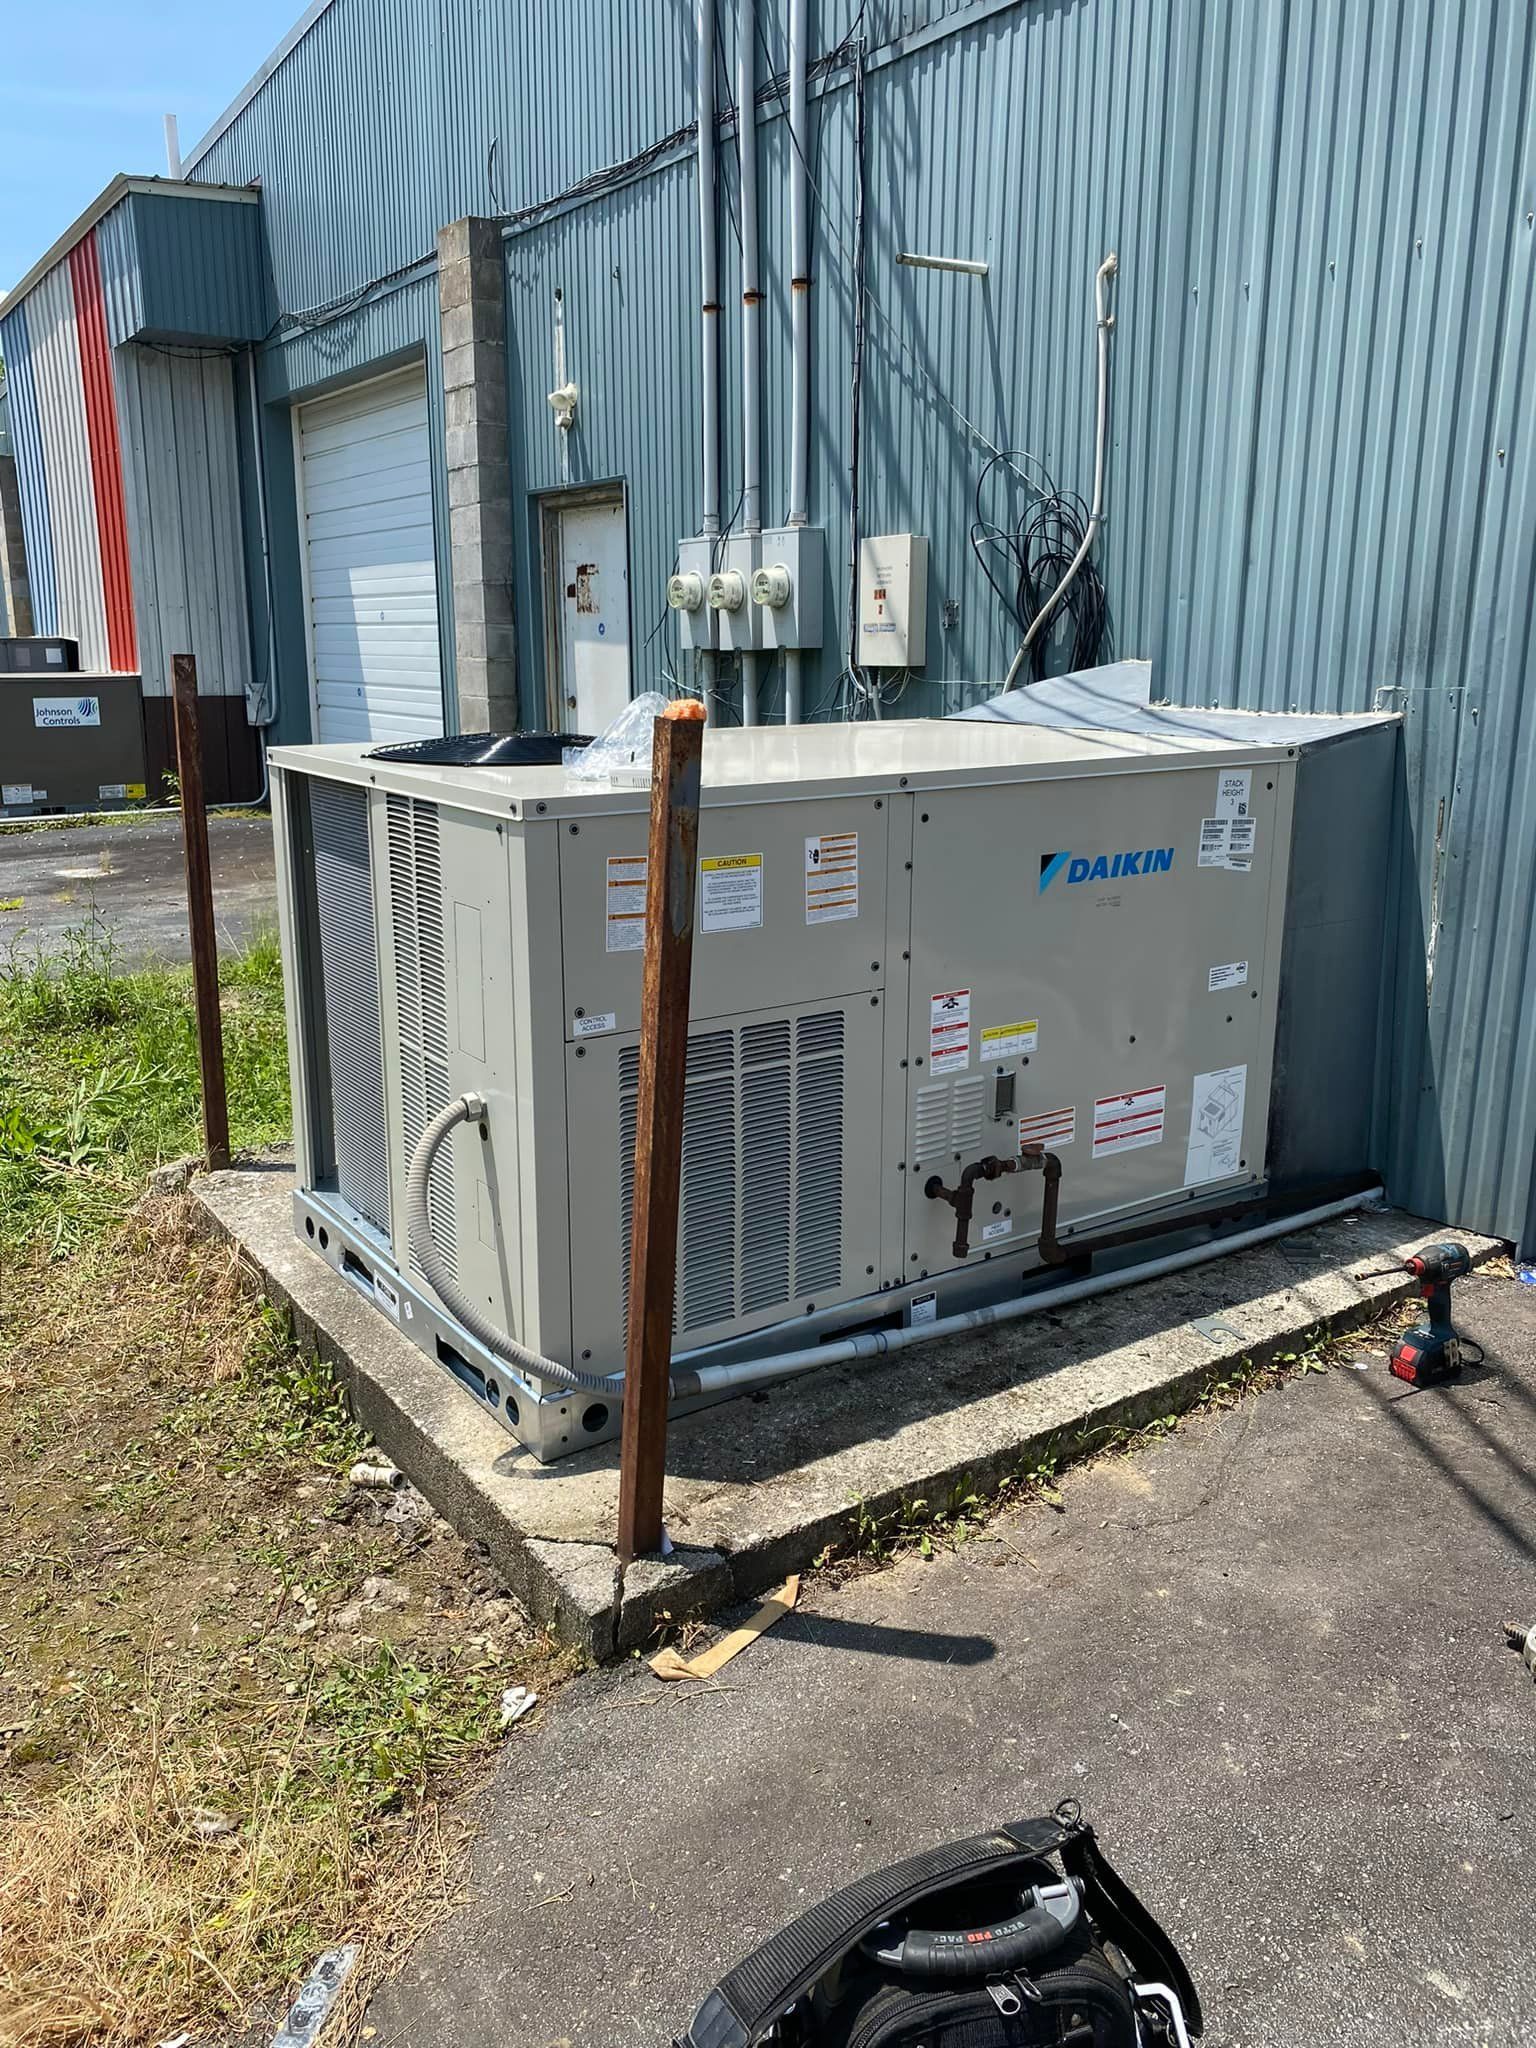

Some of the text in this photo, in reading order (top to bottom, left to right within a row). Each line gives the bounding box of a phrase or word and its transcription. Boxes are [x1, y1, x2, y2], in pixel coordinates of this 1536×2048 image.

[36, 708, 72, 717] Johnson
[43, 716, 80, 725] Controls
[1224, 779, 1244, 787] STACK
[717, 858, 747, 867] CAUTION
[1067, 848, 1174, 884] DAIKIN
[995, 1921, 1025, 1936] VETO
